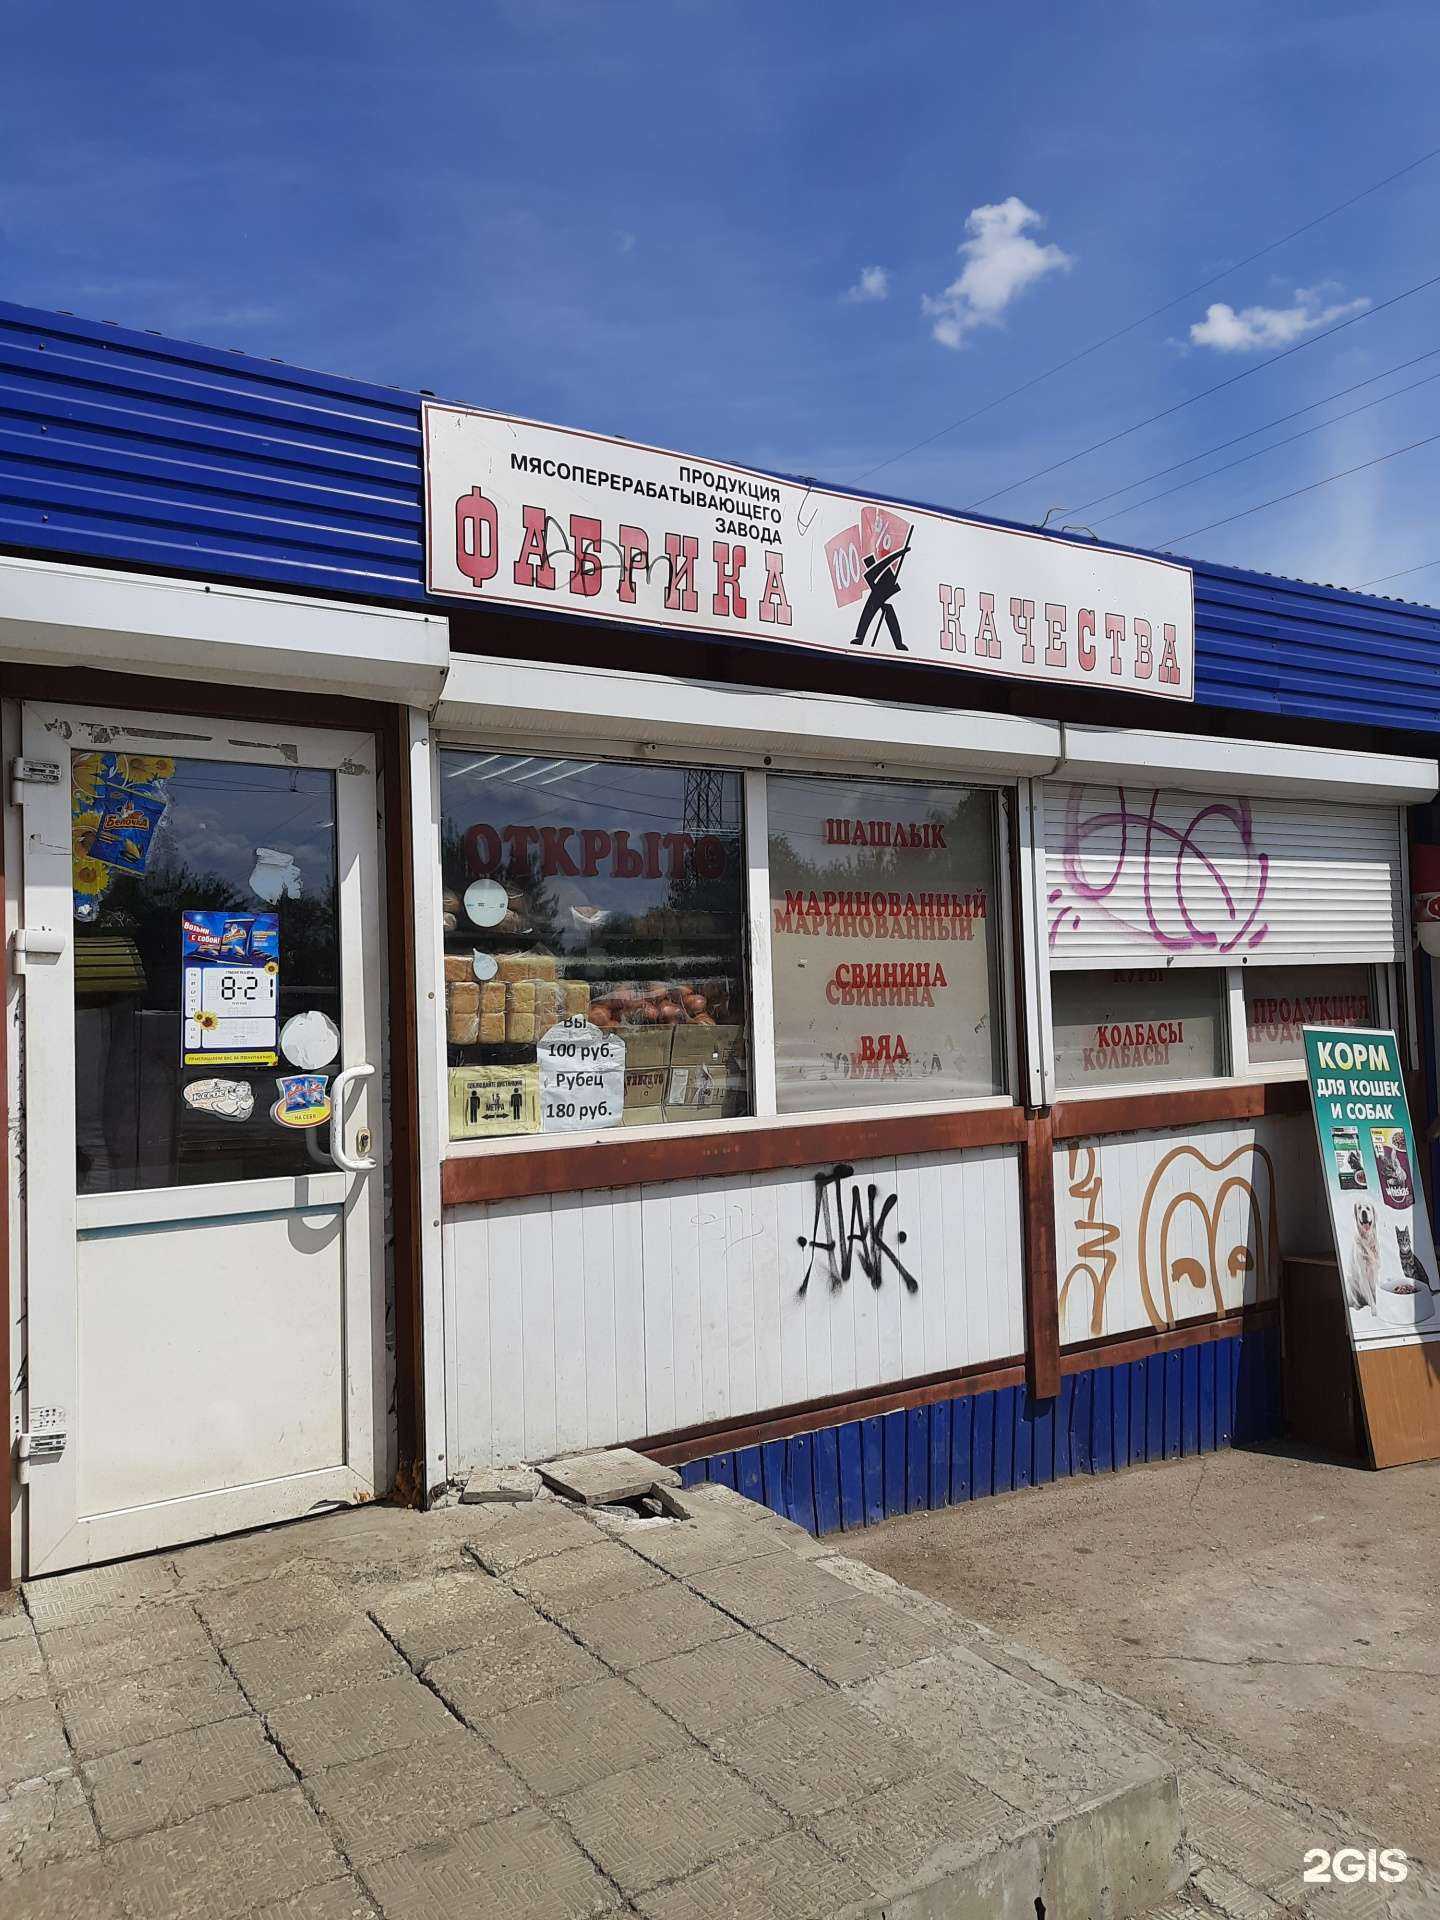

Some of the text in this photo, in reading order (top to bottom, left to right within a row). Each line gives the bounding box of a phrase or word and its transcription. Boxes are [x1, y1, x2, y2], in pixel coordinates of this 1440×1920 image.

[510, 453, 782, 524] МЯСОПЕРЕРАБАТЫВАЮЩЕГО
[679, 466, 781, 504] ПРОДУКЦИЯ
[714, 518, 783, 546] ЗАВОДА
[454, 485, 793, 626] ФАБРИКА
[938, 583, 1181, 685] КАЧЕСТВА
[826, 818, 948, 848] ШАШЛЫК
[462, 823, 728, 880] ОТКРЫТО
[784, 888, 987, 918] МАРИНОВАННЫЙ
[835, 962, 948, 988] СВИНИНА
[1098, 1022, 1184, 1047] КОЛБАСЫ
[548, 1043, 614, 1061] 100 руб.
[1317, 1041, 1390, 1071] КОРМ
[556, 1072, 604, 1091] Рубец
[1317, 1078, 1401, 1097] ДЛЯ КОШЕК
[546, 1101, 612, 1120] 180 руб.
[1330, 1102, 1395, 1120] И СОБАК
